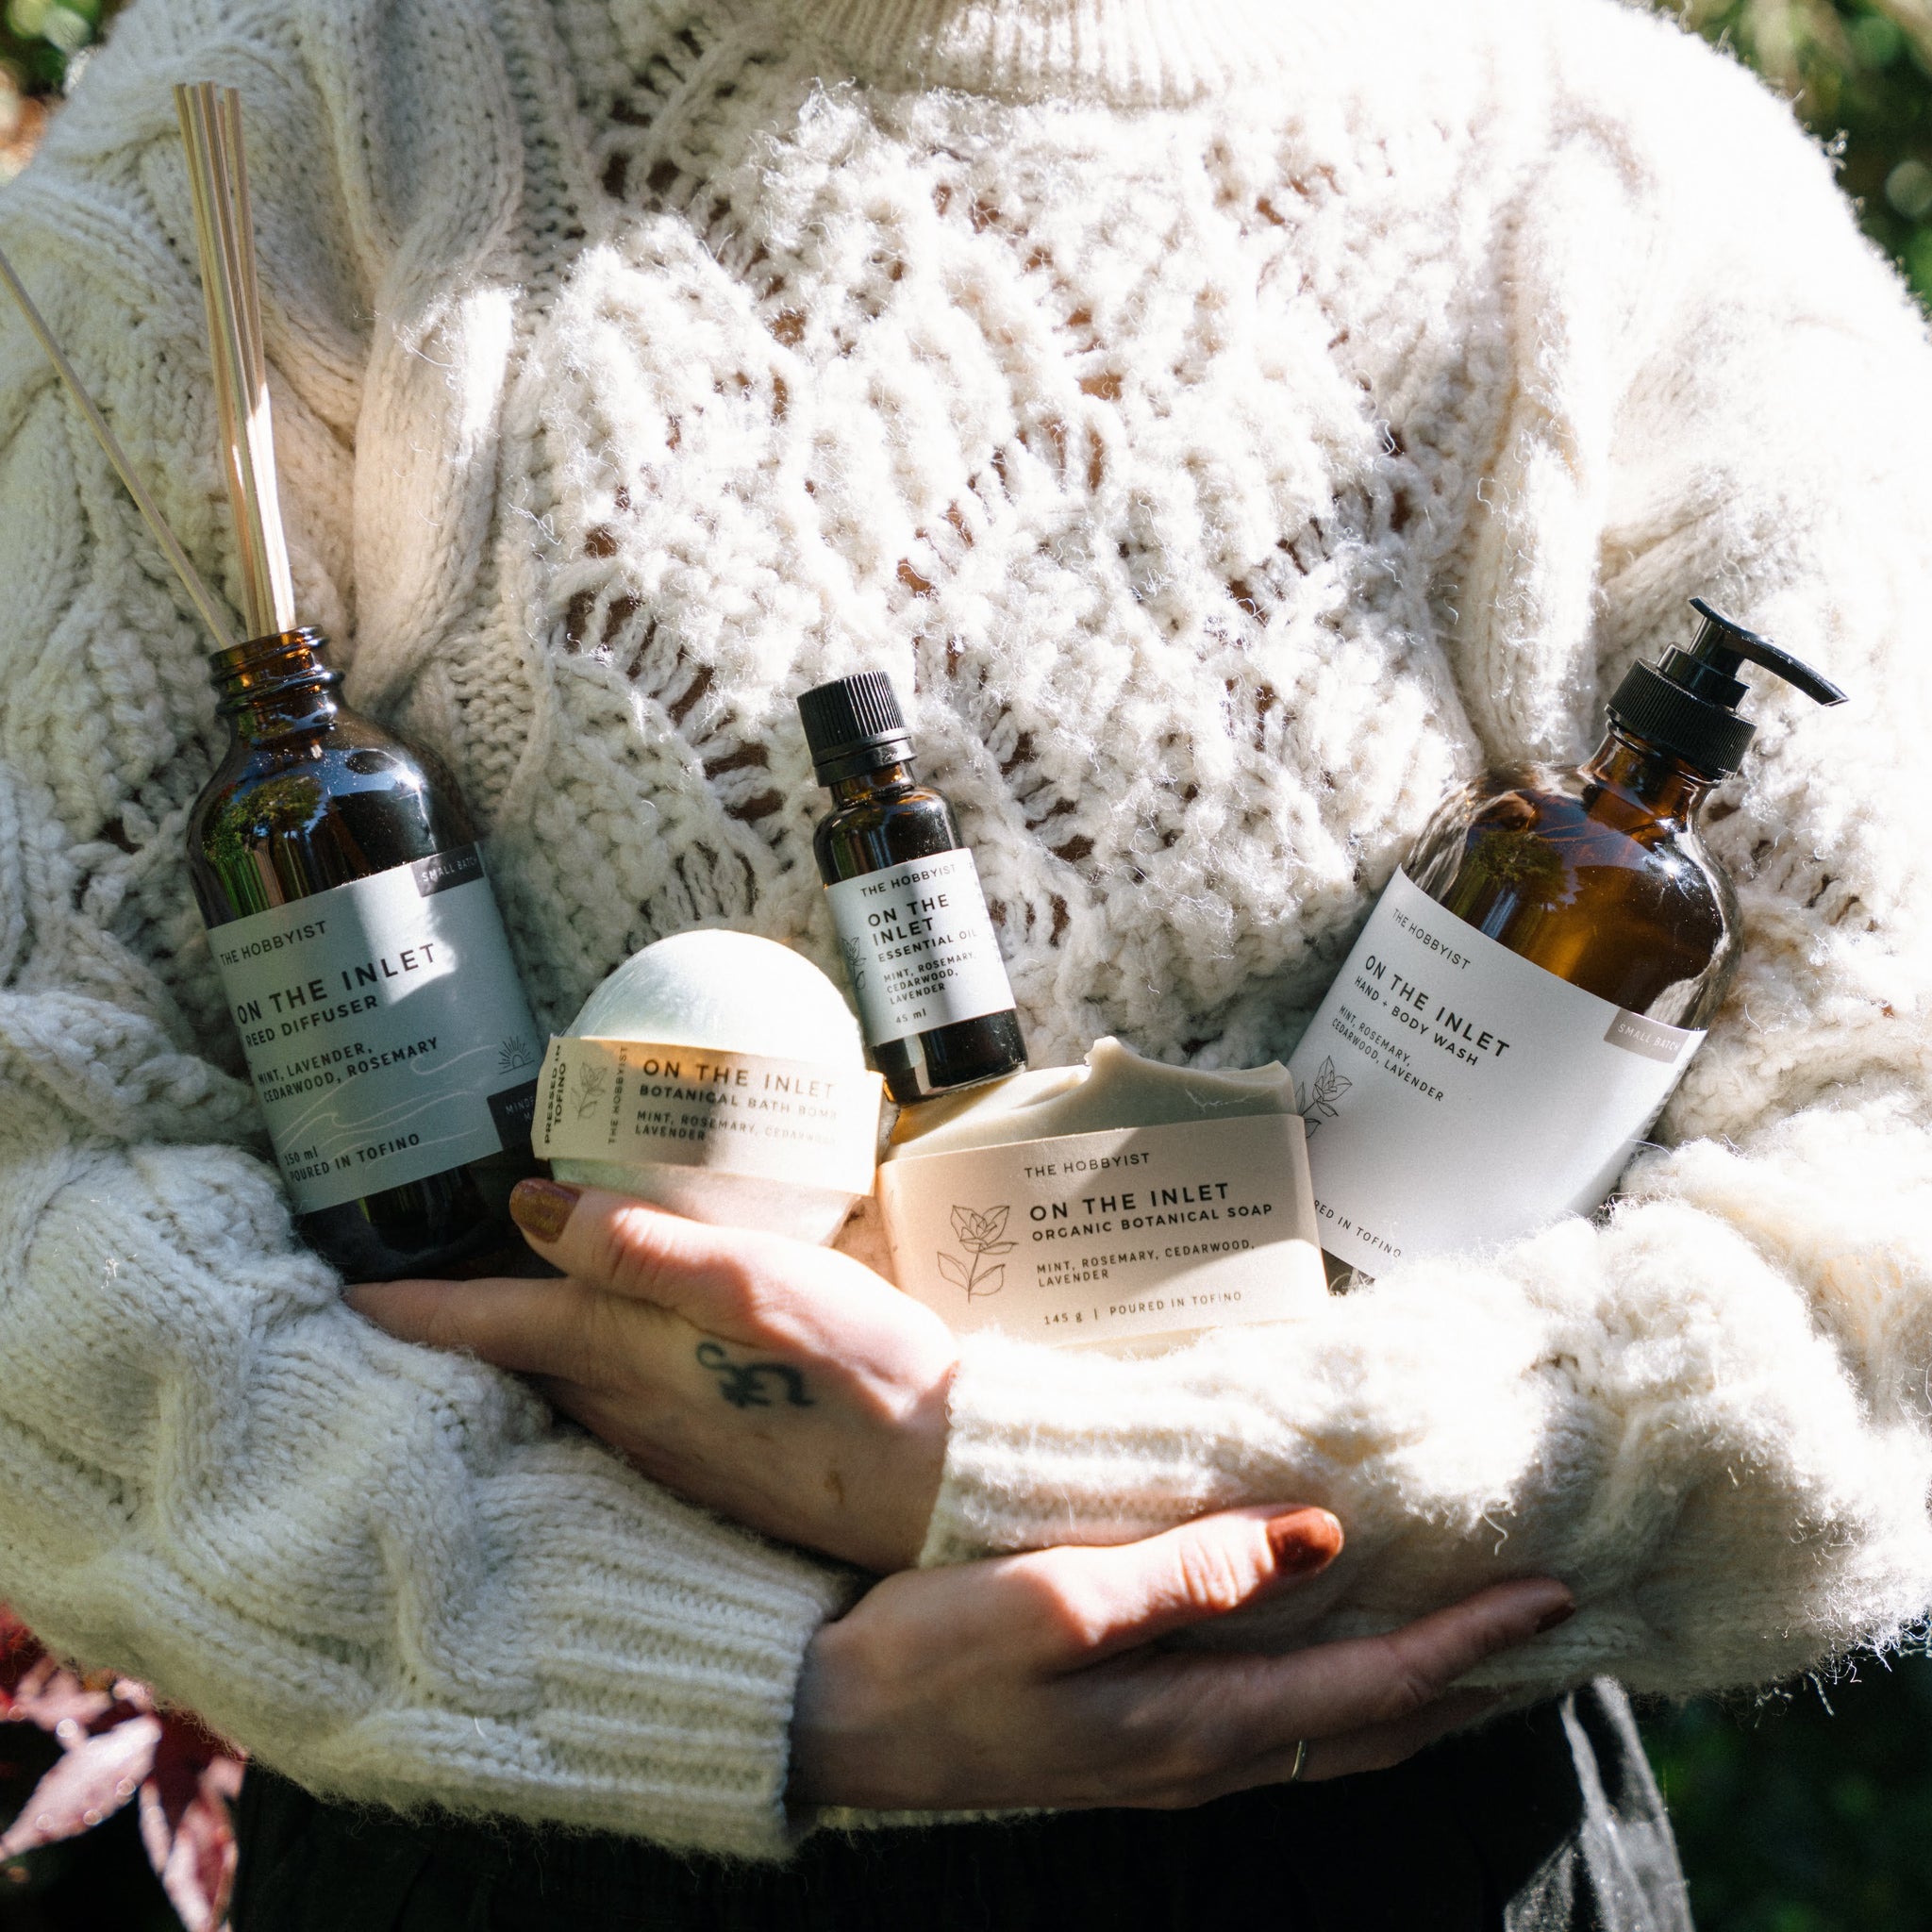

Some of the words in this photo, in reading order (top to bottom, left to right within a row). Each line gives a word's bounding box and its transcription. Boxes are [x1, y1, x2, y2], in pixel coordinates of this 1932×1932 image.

[421, 864, 456, 882] SMALL
[860, 883, 887, 897] THE
[891, 864, 957, 890] HOBBYIST
[868, 908, 897, 927] ON
[907, 894, 949, 915] THE
[220, 949, 240, 967] THE
[242, 921, 326, 959] HOBBYIST
[873, 917, 934, 946] INLET
[878, 934, 954, 962] ESSENTIAL
[958, 928, 977, 941] OIL
[1391, 908, 1407, 928] THE
[1408, 917, 1471, 971] HOBBYIST
[237, 999, 262, 1024] ON
[269, 979, 327, 1014] THE
[341, 943, 435, 991] INLET
[884, 968, 914, 983] MINT,
[886, 968, 958, 994] CEDARWOOD,
[890, 982, 946, 1005] LAVENDER
[1365, 955, 1386, 981] ON
[1391, 974, 1428, 1011] THE
[1436, 1007, 1509, 1058] INLET
[245, 1027, 275, 1049] REED
[281, 994, 378, 1036] DIFFUSER
[896, 1013, 908, 1024] 45
[913, 1008, 926, 1019] ml
[1354, 975, 1379, 1003] HAND
[1391, 1005, 1429, 1036] BODY
[1433, 1035, 1479, 1066] WASH
[1339, 1005, 1357, 1029] MINT,
[1358, 1022, 1411, 1068] ROSEMARY,
[1618, 1024, 1650, 1044] SMALL
[258, 1069, 285, 1085] MINT,
[287, 1042, 373, 1076] LAVENDER,
[263, 1072, 341, 1103] CEDARWOOD,
[346, 1037, 438, 1077] ROSEMARY
[1330, 1018, 1380, 1064] CEDARWOOD,
[1383, 1059, 1444, 1102] LAVENDER
[544, 1067, 557, 1143] PRESSED
[554, 1045, 561, 1061] IN
[555, 1063, 567, 1124] TOFINO
[611, 1046, 627, 1115] HOBBYIST
[643, 1059, 679, 1078] ON
[696, 1064, 748, 1087] THE
[764, 1073, 834, 1099] INLET
[640, 1084, 739, 1107] BOTANICAL
[748, 1097, 791, 1113] BATH
[608, 1118, 619, 1144] THE
[635, 1124, 706, 1141] LAVENDER
[637, 1110, 675, 1125] MINT,
[681, 1112, 758, 1136] ROSEMARY,
[284, 1152, 301, 1166] 150
[304, 1145, 318, 1161] ml
[289, 1161, 330, 1182] POURED
[335, 1156, 351, 1170] IN
[357, 1133, 420, 1162] TOFINO
[1024, 1164, 1058, 1178] THE
[1063, 1152, 1150, 1174] HOBBYIST
[1030, 1202, 1068, 1222] ON
[1082, 1193, 1136, 1215] THE
[1150, 1182, 1229, 1208] INLET
[1032, 1221, 1112, 1241] ORGANIC
[1121, 1208, 1219, 1231] BOTANICAL
[1227, 1204, 1274, 1220] SOAP
[1314, 1199, 1334, 1218] RED
[1338, 1217, 1351, 1229] IN
[1357, 1226, 1401, 1257] TOFINO
[1037, 1260, 1075, 1274] MINT,
[1081, 1249, 1159, 1268] ROSEMARY,
[1165, 1239, 1255, 1258] CEDARWOOD,
[1038, 1270, 1108, 1288] LAVENDER
[1043, 1312, 1069, 1324] 145
[1075, 1312, 1083, 1324] g
[1109, 1302, 1164, 1317] POURED
[1171, 1298, 1185, 1308] IN
[1192, 1291, 1242, 1307] TOFINO
